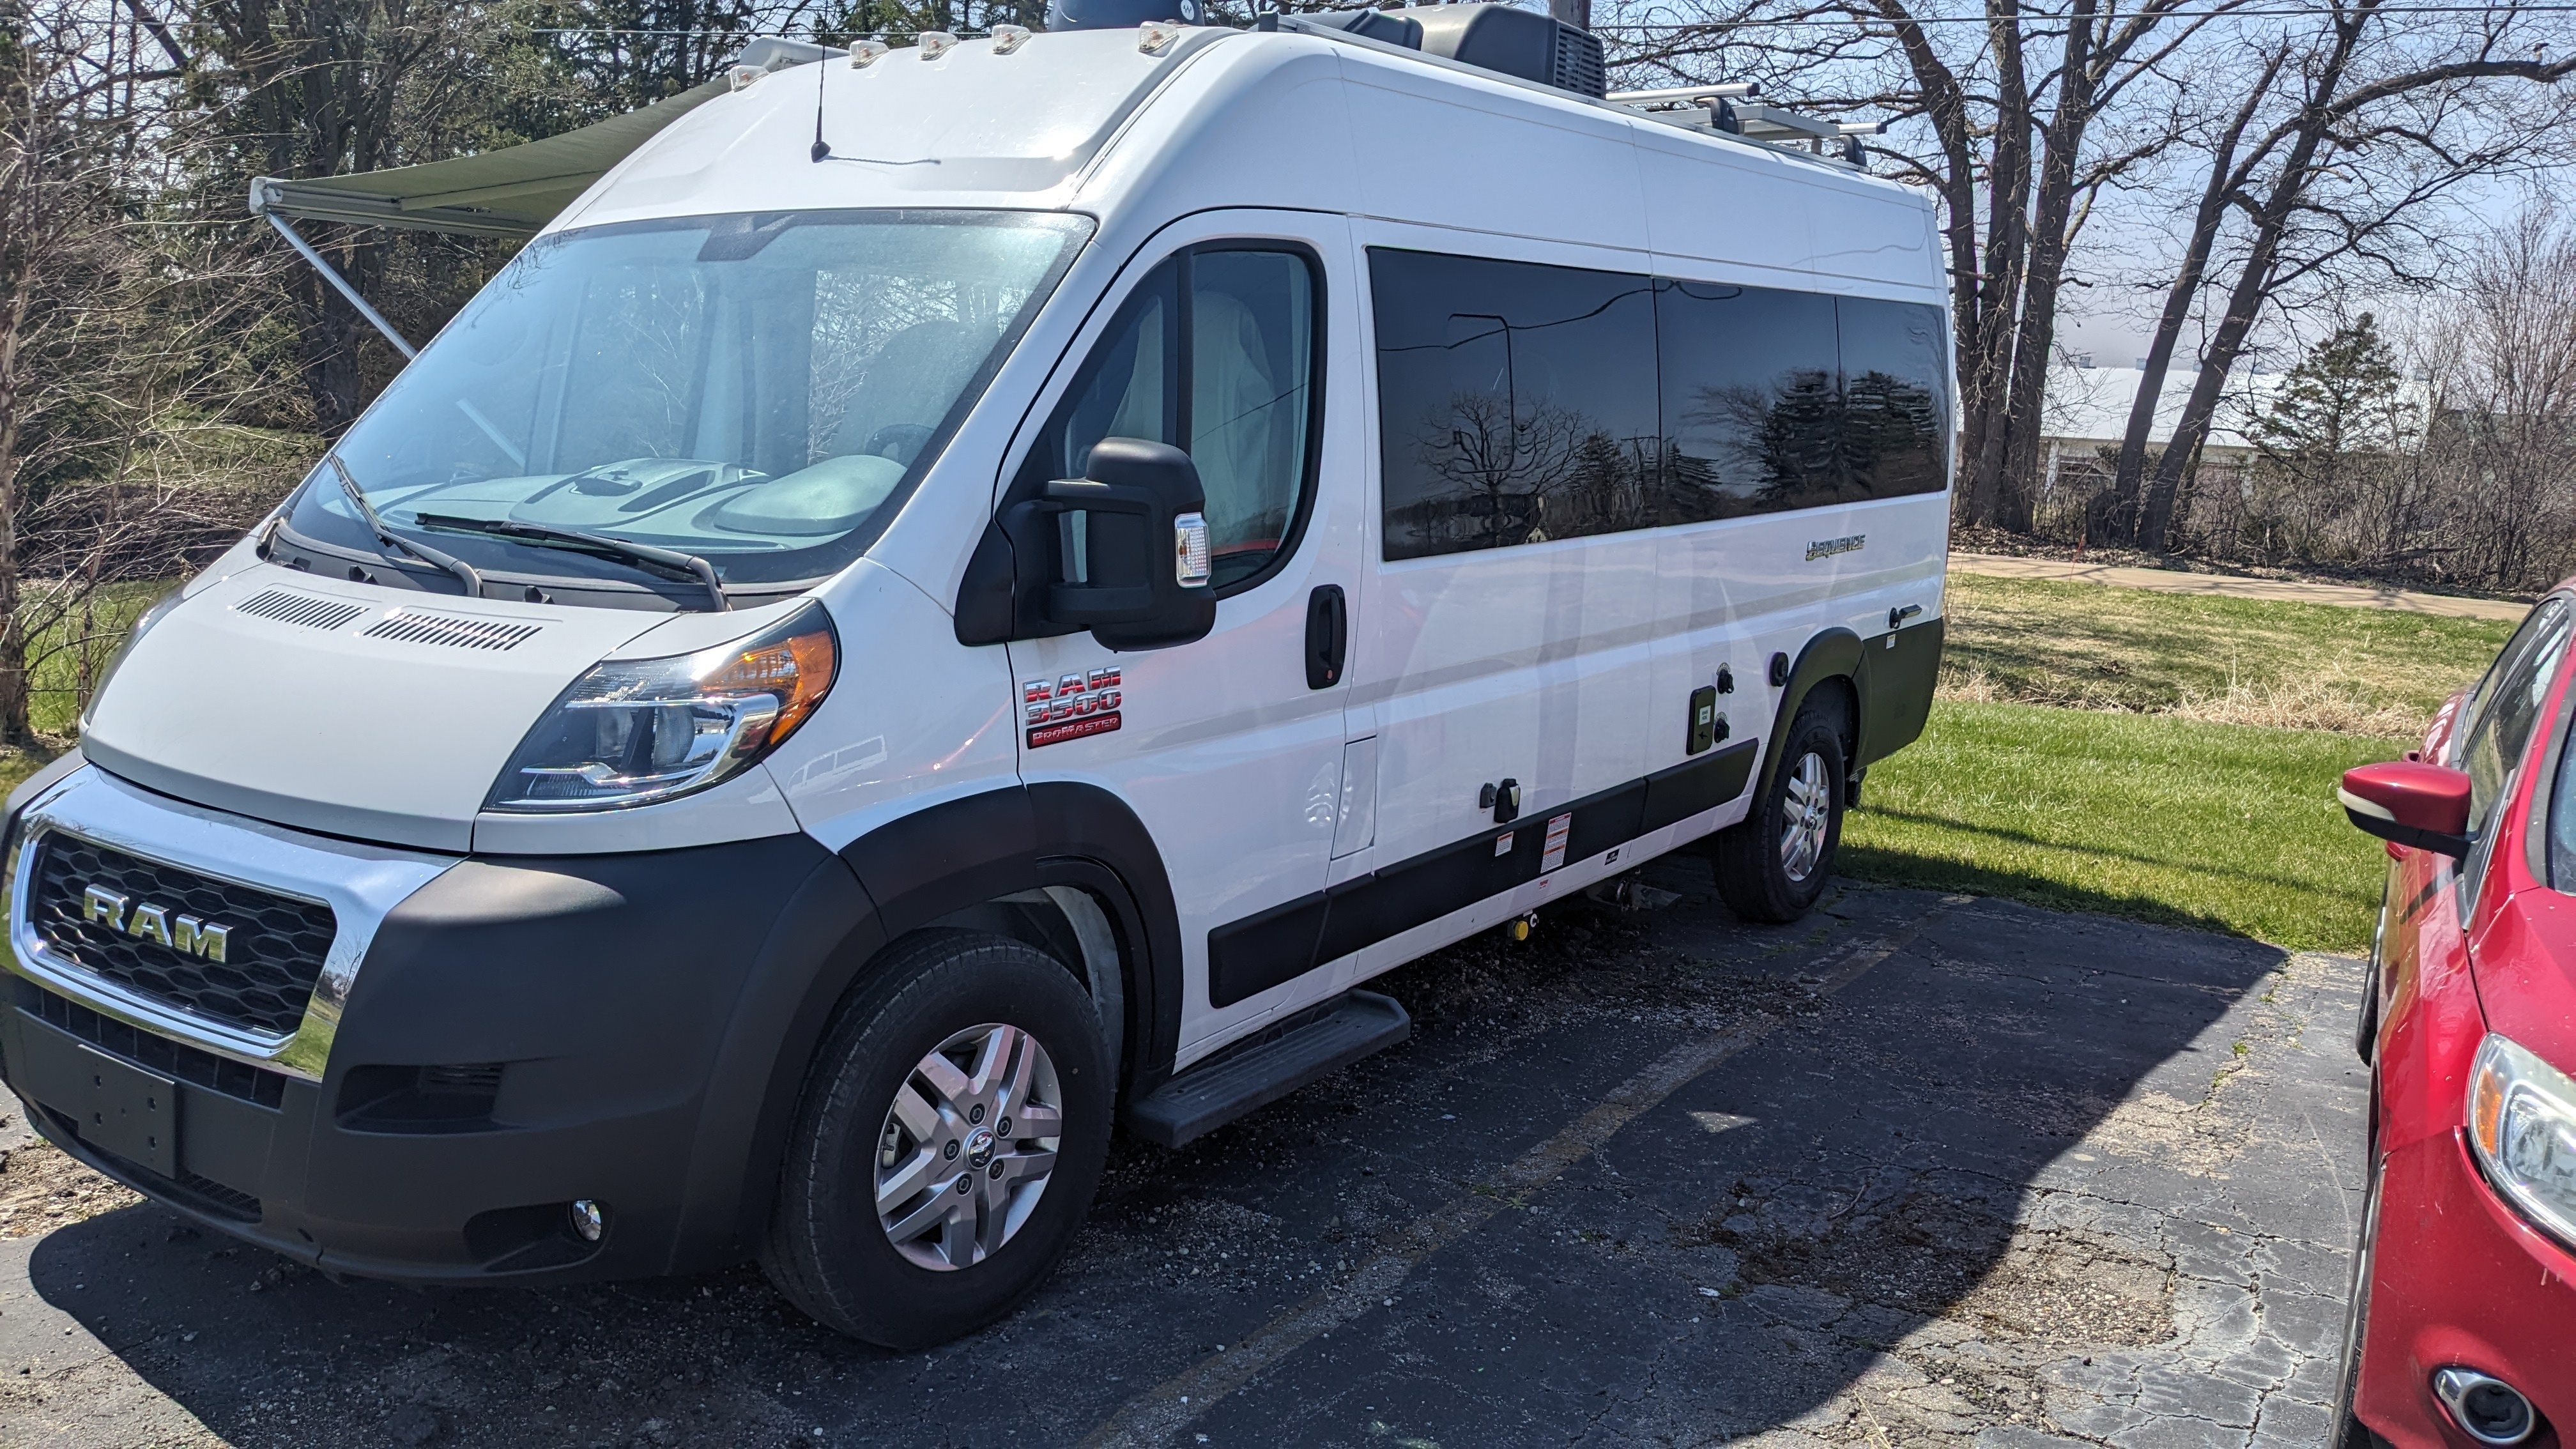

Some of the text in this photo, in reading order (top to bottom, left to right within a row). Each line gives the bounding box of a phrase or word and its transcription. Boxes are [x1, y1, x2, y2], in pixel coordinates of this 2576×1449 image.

[1805, 535, 1865, 561] SEQUENCE
[1023, 666, 1121, 702] RAM
[1025, 688, 1122, 725] 3500
[84, 884, 234, 962] RAM
